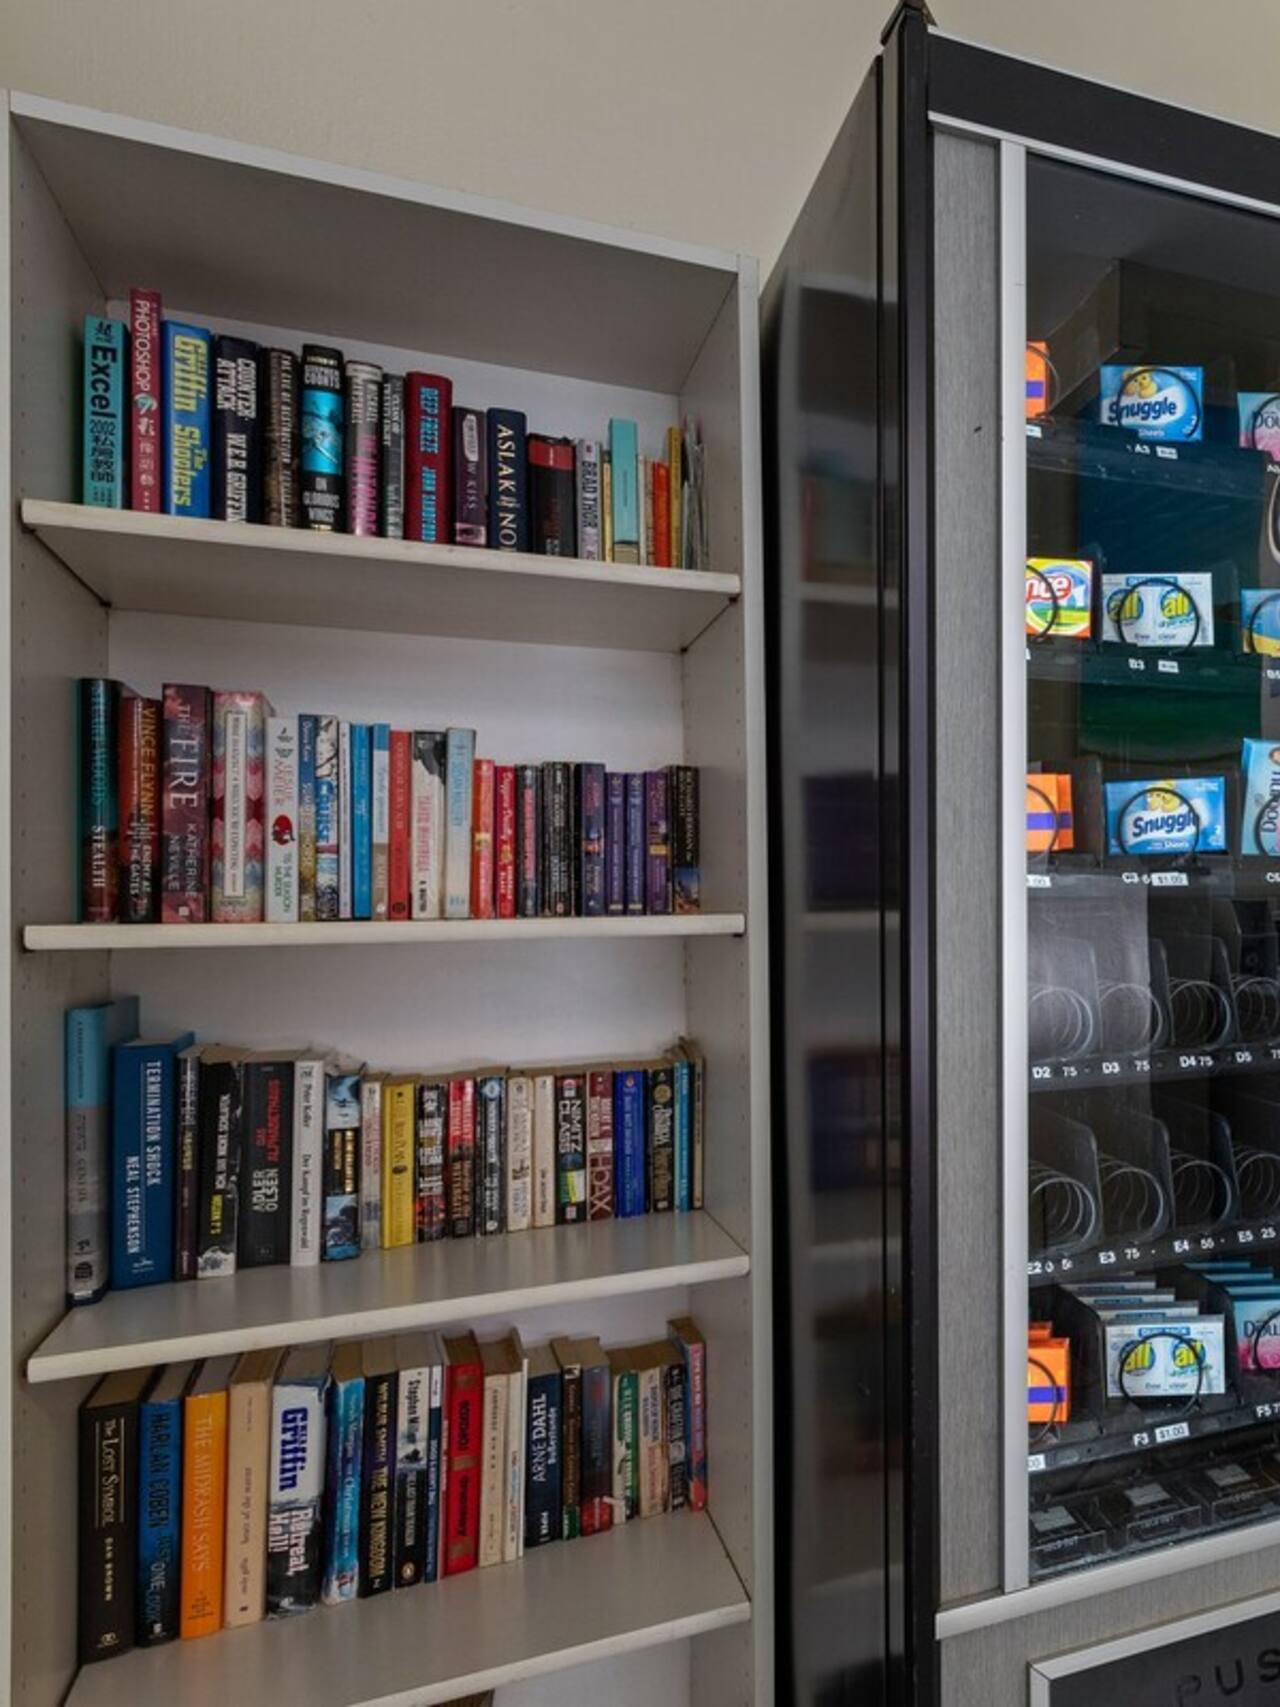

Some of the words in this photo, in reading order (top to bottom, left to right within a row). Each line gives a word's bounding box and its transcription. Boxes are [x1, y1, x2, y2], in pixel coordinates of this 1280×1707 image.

[135, 299, 151, 391] PHOTOSHOP
[91, 345, 116, 420] Excel
[174, 335, 207, 412] Griffin
[216, 358, 236, 410] ATTACK
[420, 387, 438, 414] DEEP
[1109, 396, 1177, 422] Snuggle
[420, 416, 439, 454] FREEZE
[173, 424, 201, 506] Shooters
[497, 424, 516, 493] ASLAK
[467, 480, 477, 510] KISS
[582, 460, 597, 494] BRAD
[226, 471, 247, 523] GRIFFIN
[582, 496, 597, 528] THOR
[1109, 590, 1140, 623] all
[1163, 590, 1191, 619] all
[1128, 658, 1145, 670] B3
[141, 706, 155, 756] VINCE
[177, 704, 190, 738] THE
[140, 762, 155, 816] FLYNN
[169, 736, 199, 810] FIRE
[91, 825, 107, 888] STEALTH
[130, 843, 140, 862] THE
[142, 845, 152, 876] ENEMY
[185, 823, 197, 898] KATHERINE
[1163, 840, 1190, 849] Sheets
[129, 864, 140, 895] GATES
[168, 835, 180, 891] NEVILLE
[1121, 872, 1139, 884] C3
[142, 878, 151, 892] AT
[1032, 1066, 1051, 1079] D2
[1062, 1066, 1078, 1077] 75
[1102, 1062, 1120, 1074] D3
[1135, 1060, 1151, 1071] 75
[1179, 1055, 1196, 1068] D4
[1198, 1055, 1214, 1067] 75
[1236, 1050, 1253, 1063] D5
[146, 1061, 161, 1143] TERMINATION
[302, 1084, 312, 1104] Peter
[558, 1100, 570, 1154] CLASS
[572, 1099, 582, 1153] NIMITZ
[126, 1156, 140, 1183] NEAL
[146, 1145, 161, 1187] SHOCK
[302, 1154, 312, 1169] Der
[253, 1169, 265, 1212] ADLER
[266, 1168, 279, 1212] OLSEN
[298, 1171, 312, 1195] Kampf
[590, 1154, 611, 1214] HOAX
[301, 1196, 310, 1207] im
[126, 1186, 140, 1254] STEPHENSON
[299, 1209, 311, 1249] Regenwald
[1237, 1231, 1254, 1244] E5
[1261, 1228, 1277, 1240] 25
[1099, 1252, 1117, 1265] E3
[1125, 1248, 1141, 1260] 75
[1173, 1240, 1190, 1253] E4
[376, 1382, 388, 1425] WILBUR
[406, 1380, 421, 1416] Stephen
[1169, 1382, 1188, 1390] clear
[104, 1419, 117, 1437] The
[533, 1393, 547, 1439] DAHL
[1255, 1404, 1272, 1418] F5
[149, 1413, 169, 1474] HARLAN
[193, 1415, 212, 1448] THE
[279, 1407, 308, 1492] Griffin
[376, 1427, 388, 1463] SMITH
[548, 1406, 558, 1464] Bußestunde
[1159, 1425, 1186, 1440] $1.00
[371, 1466, 388, 1489] THE
[532, 1441, 546, 1482] ARNE
[148, 1480, 168, 1529] COBEN
[192, 1454, 211, 1529] MIDRASH
[241, 1496, 250, 1509] the
[370, 1492, 387, 1520] NEW
[105, 1537, 113, 1559] DAN
[268, 1511, 291, 1553] Hell!
[287, 1508, 313, 1576] Retreat,
[369, 1521, 387, 1578] KINGDOM
[191, 1533, 211, 1573] SAYS
[104, 1563, 113, 1602] BROWN
[150, 1561, 166, 1590] ONE
[145, 1589, 160, 1623] LOOK
